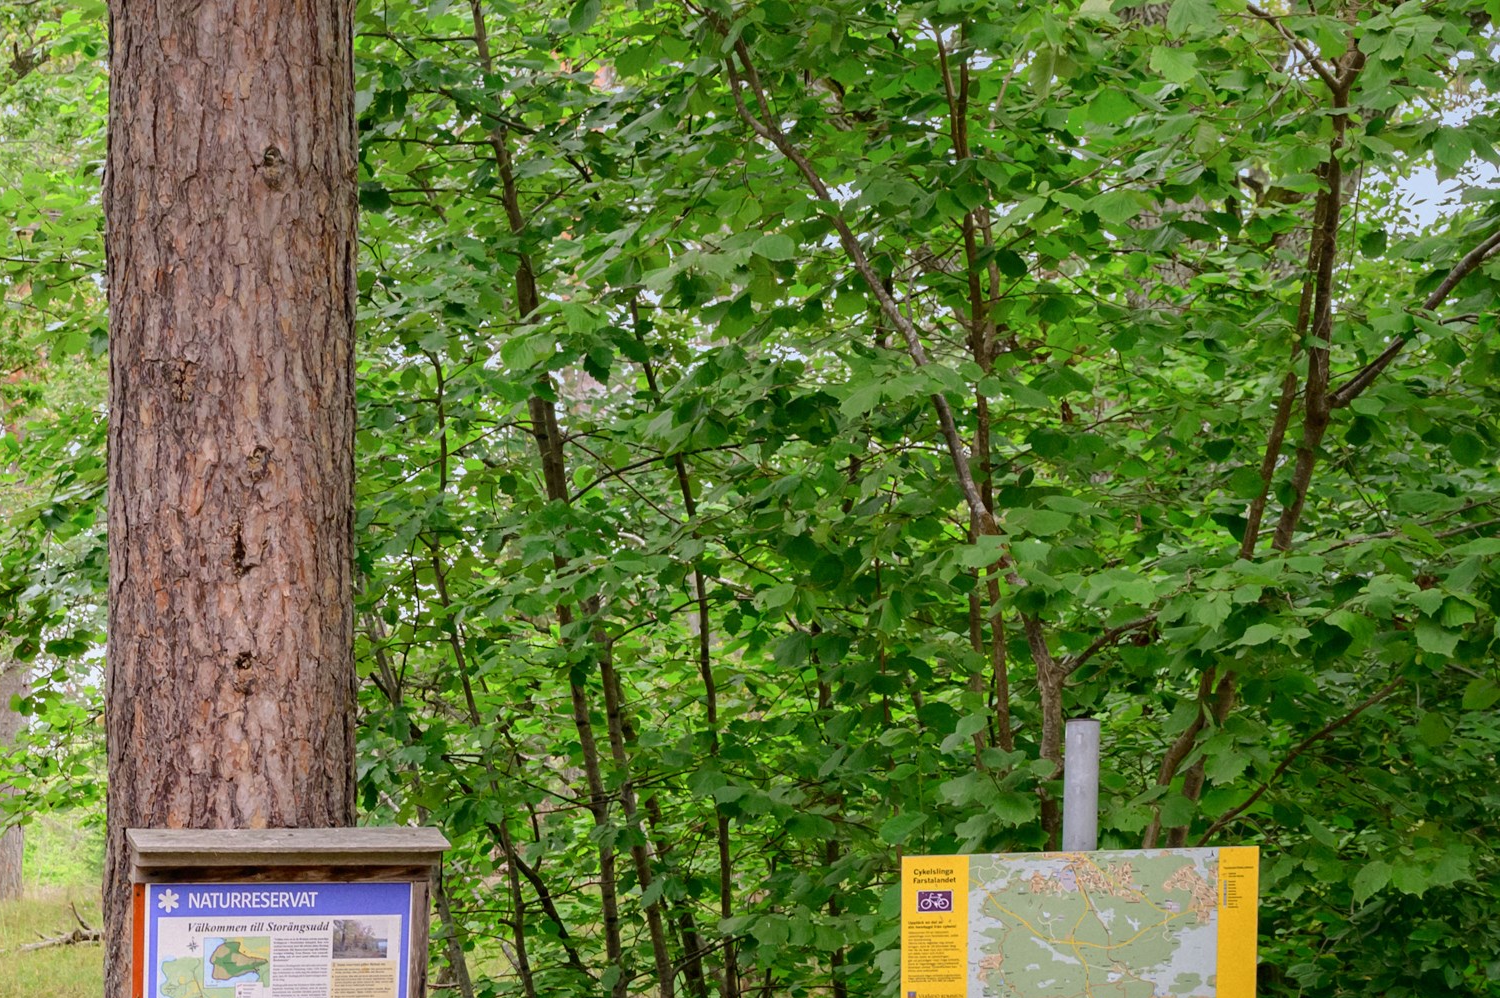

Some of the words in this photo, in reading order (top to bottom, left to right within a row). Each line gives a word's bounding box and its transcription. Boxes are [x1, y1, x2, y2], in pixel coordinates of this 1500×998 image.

[913, 868, 954, 876] Cykelslinga
[188, 891, 318, 909] NATURRESERVAT
[188, 922, 247, 932] Välkommen
[250, 921, 264, 932] till
[266, 921, 329, 933] Storängsudd
